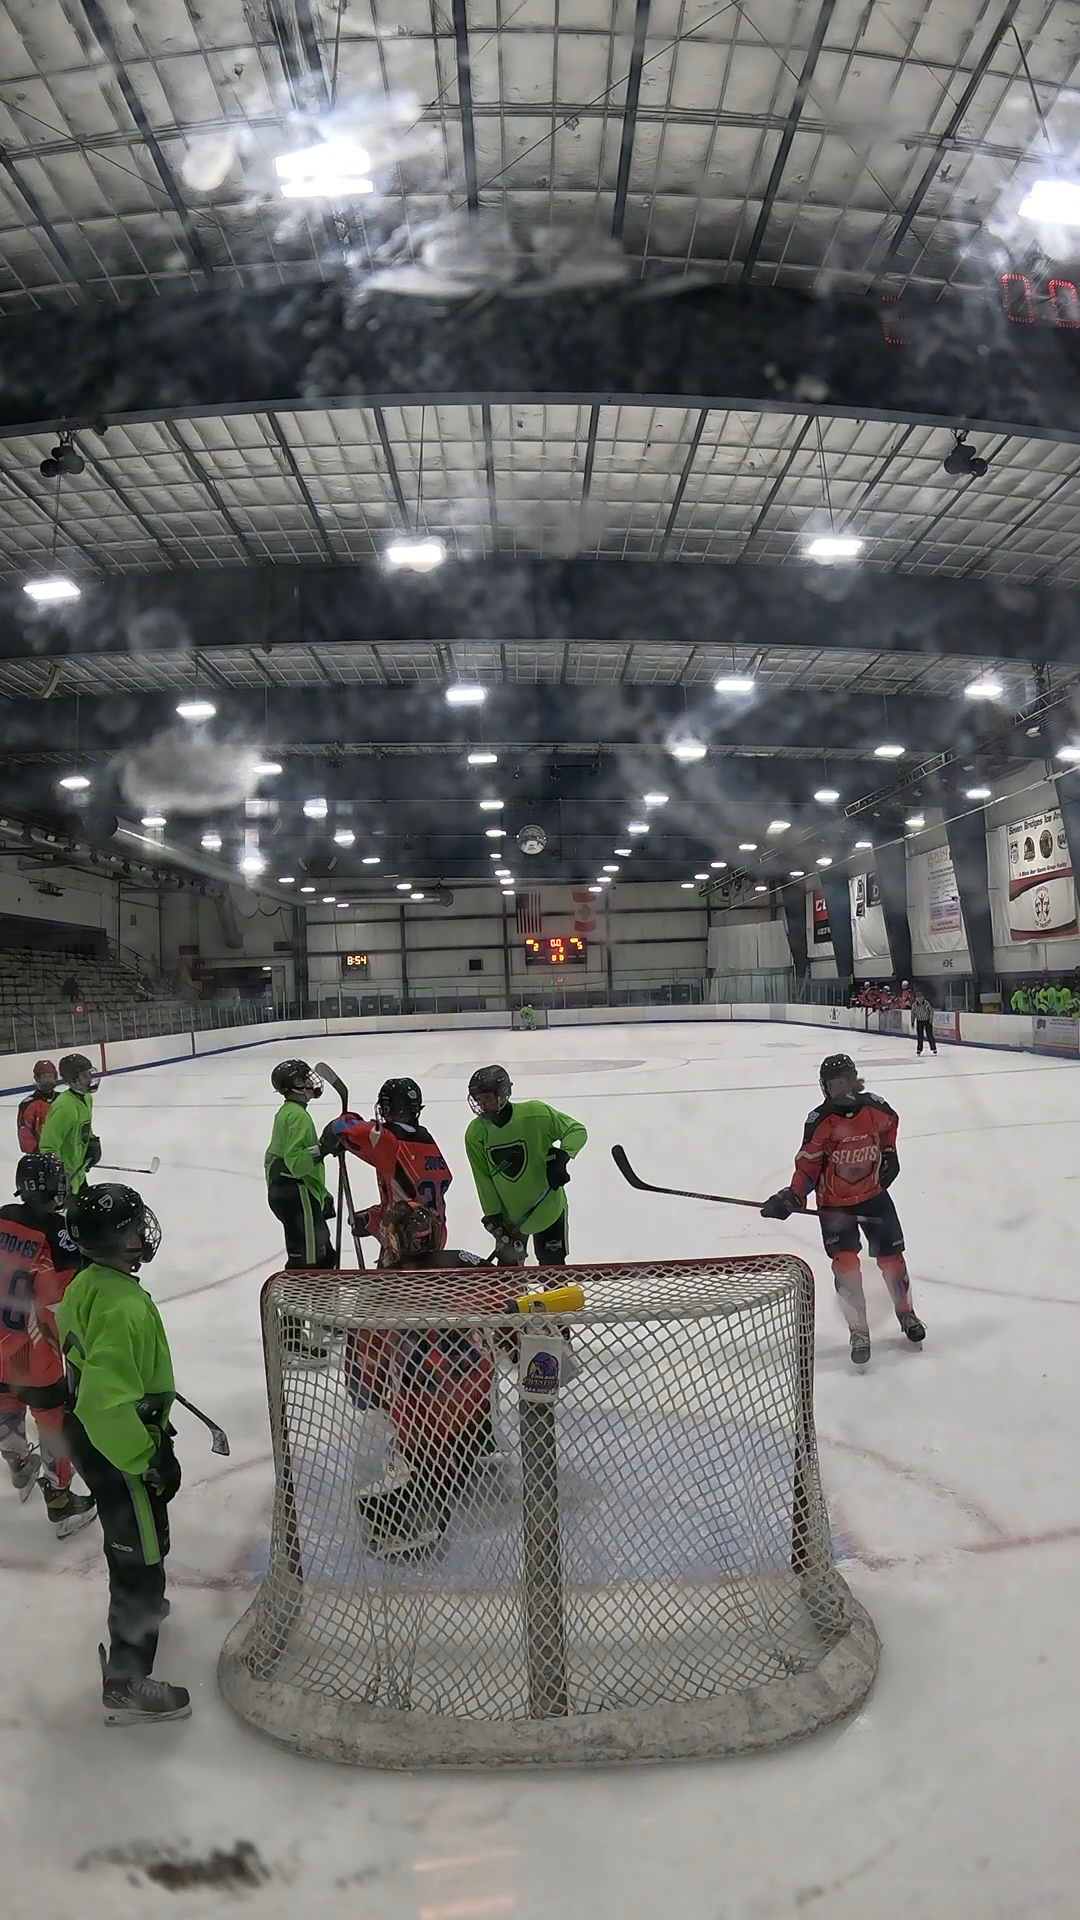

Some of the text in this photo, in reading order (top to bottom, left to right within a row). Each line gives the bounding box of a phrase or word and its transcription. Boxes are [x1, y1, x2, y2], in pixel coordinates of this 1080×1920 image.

[1008, 825, 1023, 835] Seven
[1024, 818, 1043, 830] Bridges
[1044, 815, 1052, 824] Ice
[533, 942, 539, 951] 2
[577, 941, 583, 950] 5
[347, 955, 367, 966] 8:54
[842, 1133, 868, 1143] CCM
[832, 1146, 879, 1164] SELECTS
[24, 1178, 37, 1192] 13
[115, 1217, 132, 1230] CCM
